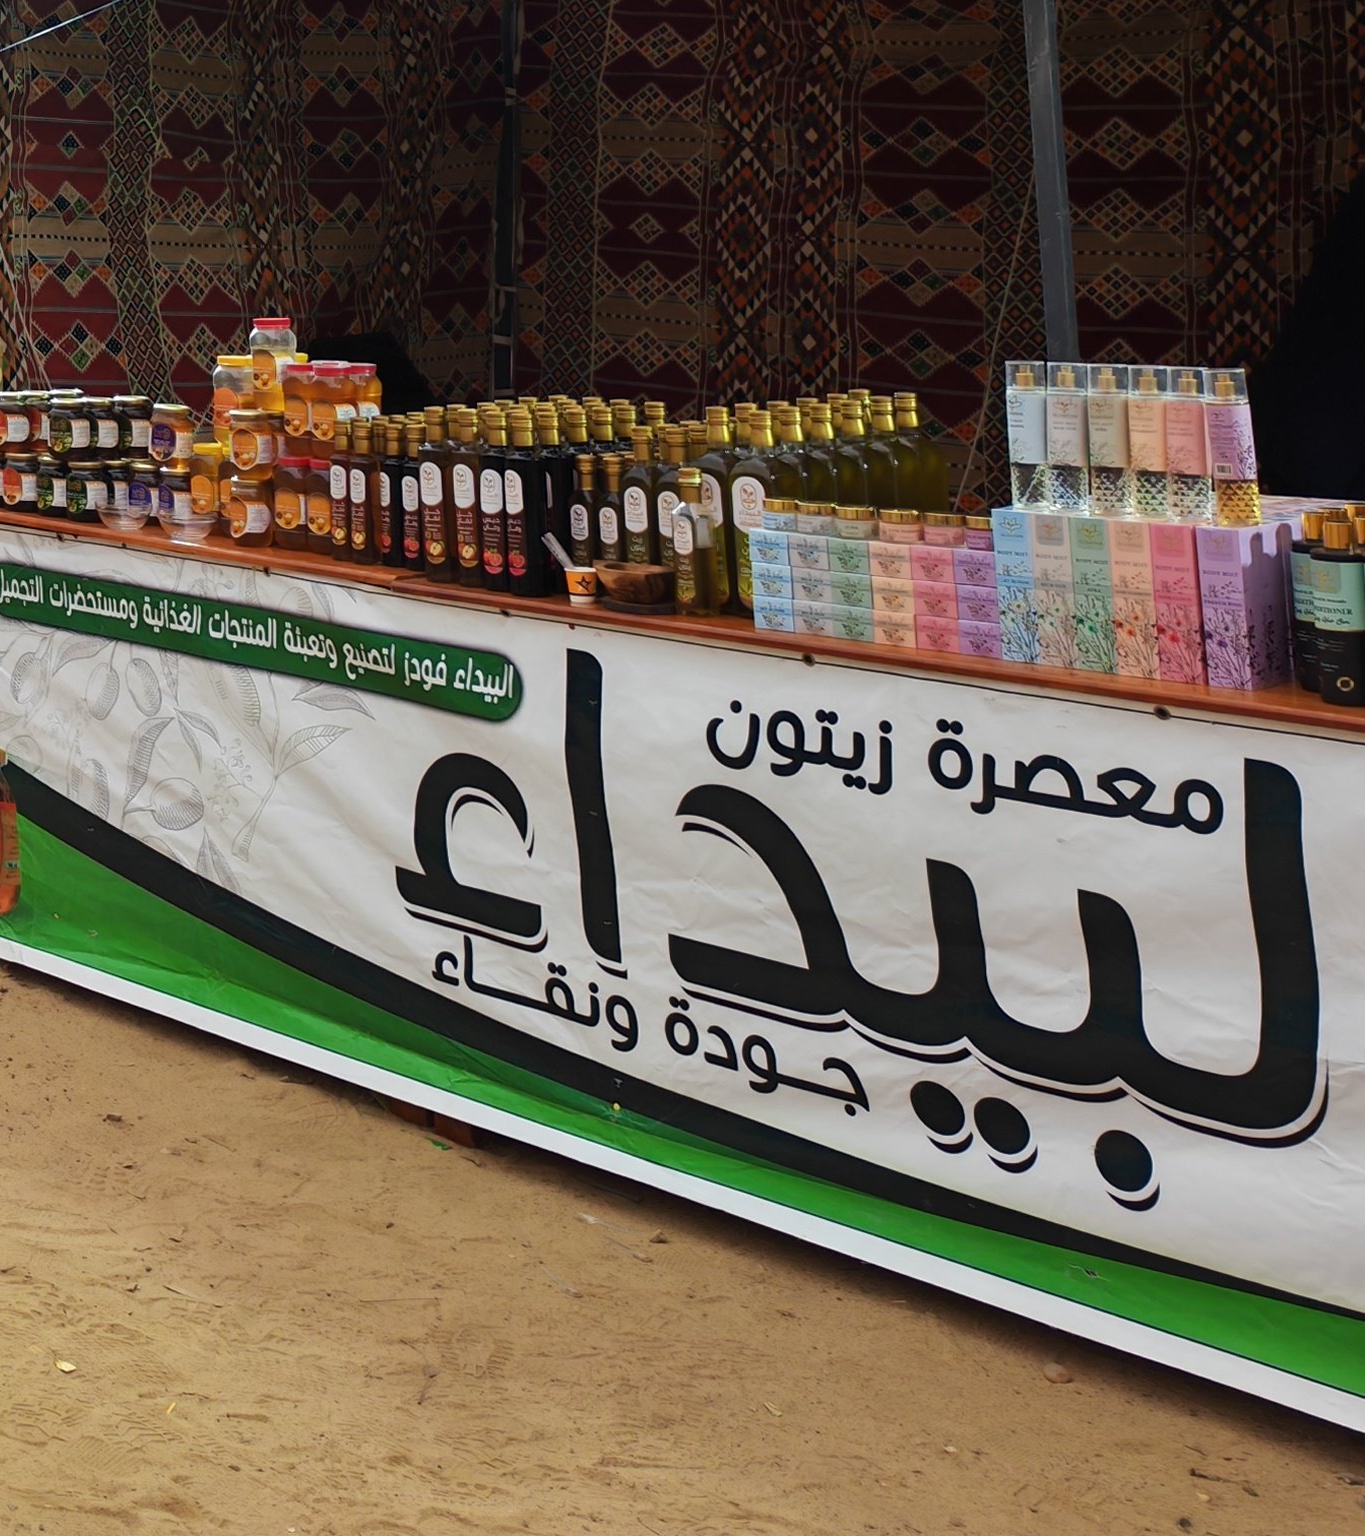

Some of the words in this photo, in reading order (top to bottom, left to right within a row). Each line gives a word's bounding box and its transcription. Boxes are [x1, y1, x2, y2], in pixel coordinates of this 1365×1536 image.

[49, 582, 138, 631] ومستحضرات
[142, 596, 202, 636] الغذائية
[208, 612, 277, 650] المنتجات
[283, 621, 338, 669] وتعبئة
[344, 643, 397, 681] لتصنيع
[404, 651, 447, 687] فودز
[451, 662, 514, 705] البيداء
[705, 699, 893, 795] زيتون
[927, 718, 1224, 835] معصرة
[432, 935, 639, 1053] ونقاء
[665, 995, 871, 1118] جودة
